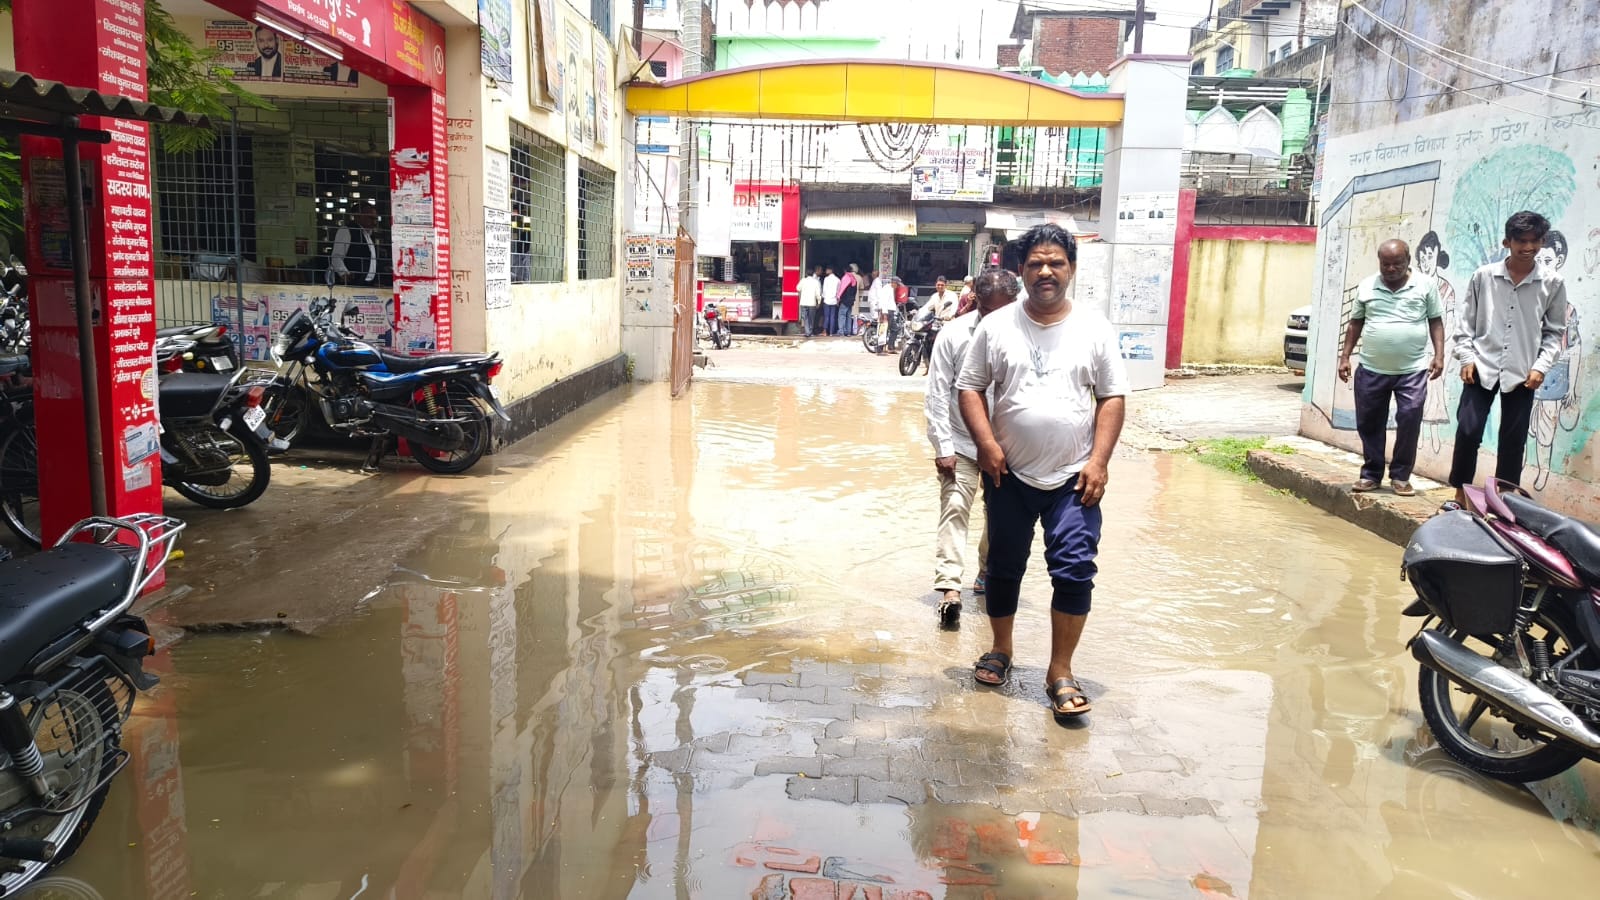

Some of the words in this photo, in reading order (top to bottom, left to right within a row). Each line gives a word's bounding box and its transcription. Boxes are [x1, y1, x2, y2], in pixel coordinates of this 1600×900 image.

[217, 40, 233, 51] 95
[295, 42, 310, 54] 95
[1375, 142, 1409, 162] विकास
[1490, 118, 1530, 144] प्रदेश
[107, 179, 132, 197] सदस्य
[273, 310, 289, 320] 95
[349, 313, 364, 323] 95
